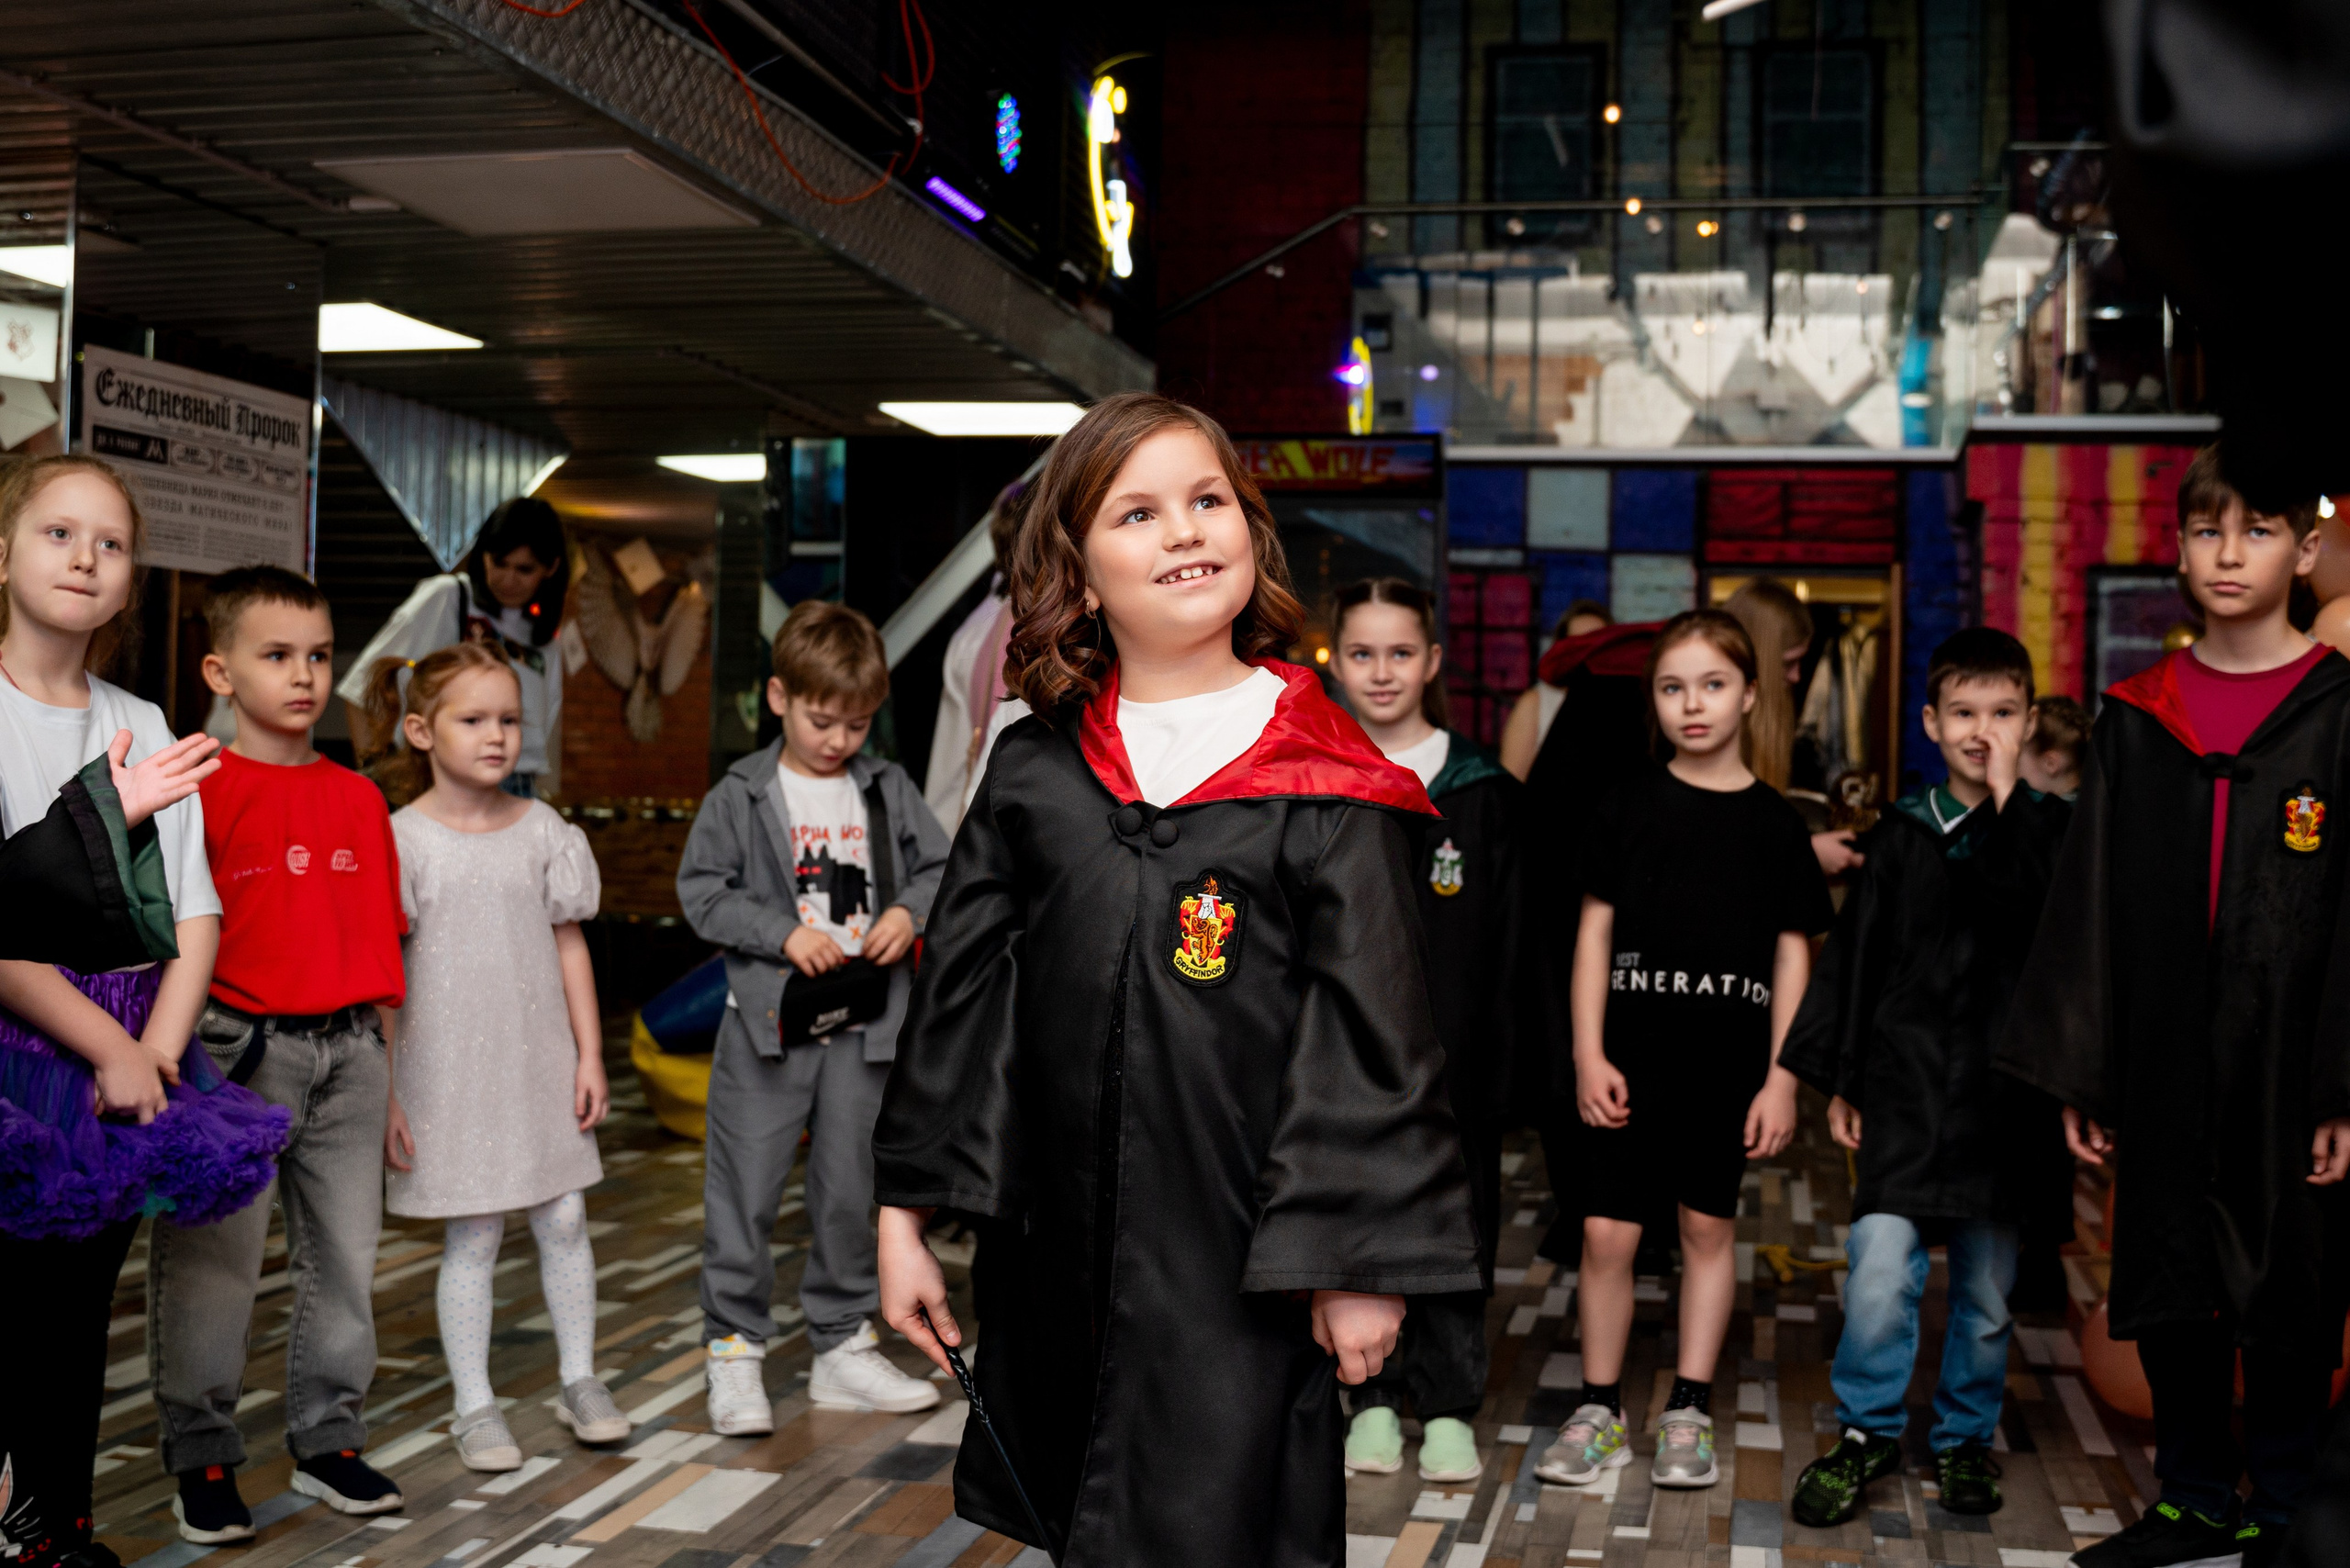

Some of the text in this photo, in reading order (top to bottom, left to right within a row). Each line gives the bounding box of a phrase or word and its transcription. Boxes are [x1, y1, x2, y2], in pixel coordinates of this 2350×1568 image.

[95, 366, 230, 432] Ежедневный
[236, 403, 301, 453] Пророк
[1175, 957, 1224, 978] GRYFFINDOR
